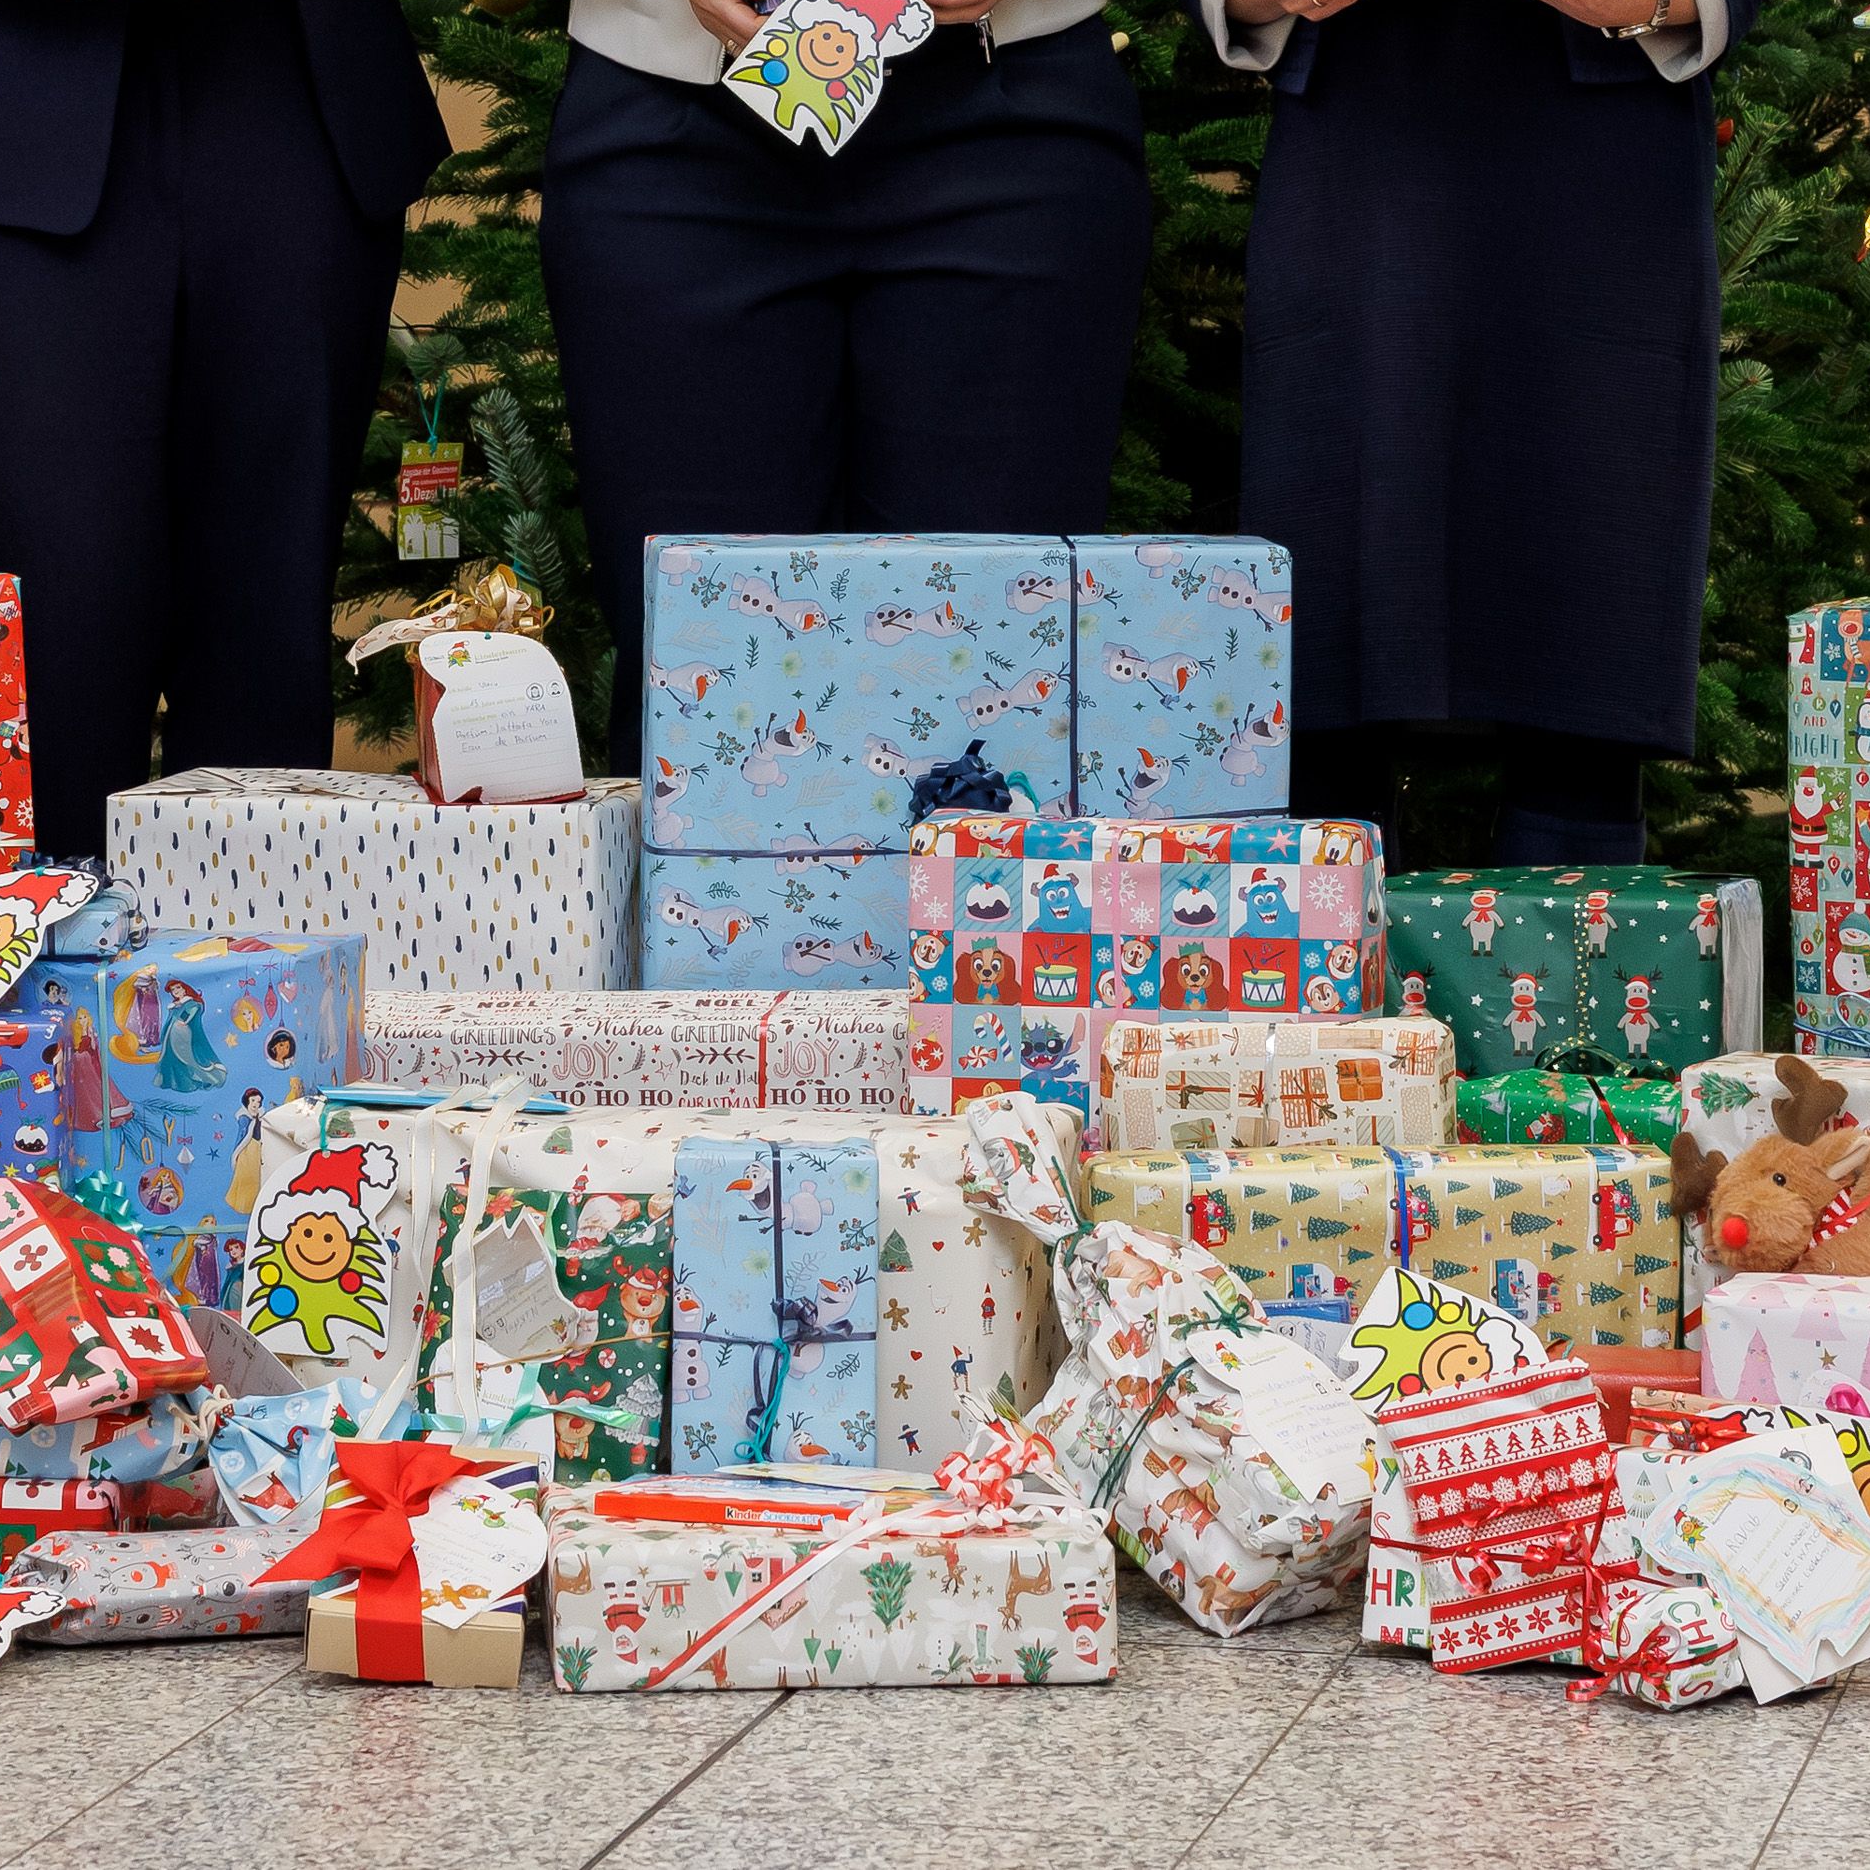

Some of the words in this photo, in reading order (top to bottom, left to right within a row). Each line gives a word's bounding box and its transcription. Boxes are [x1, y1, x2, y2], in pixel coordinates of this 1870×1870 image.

[1803, 716, 1828, 728] AND
[450, 1025, 557, 1047] GREETINGS
[587, 1018, 666, 1038] Wishes
[808, 1016, 887, 1036] Wishes
[552, 1041, 619, 1081] JOY
[774, 1038, 840, 1079] JOY
[594, 1089, 630, 1107] HO
[639, 1089, 673, 1107] HO
[771, 1088, 807, 1106] HO
[815, 1088, 851, 1106] HO
[860, 1088, 896, 1106] HO
[726, 1507, 761, 1520] kinder
